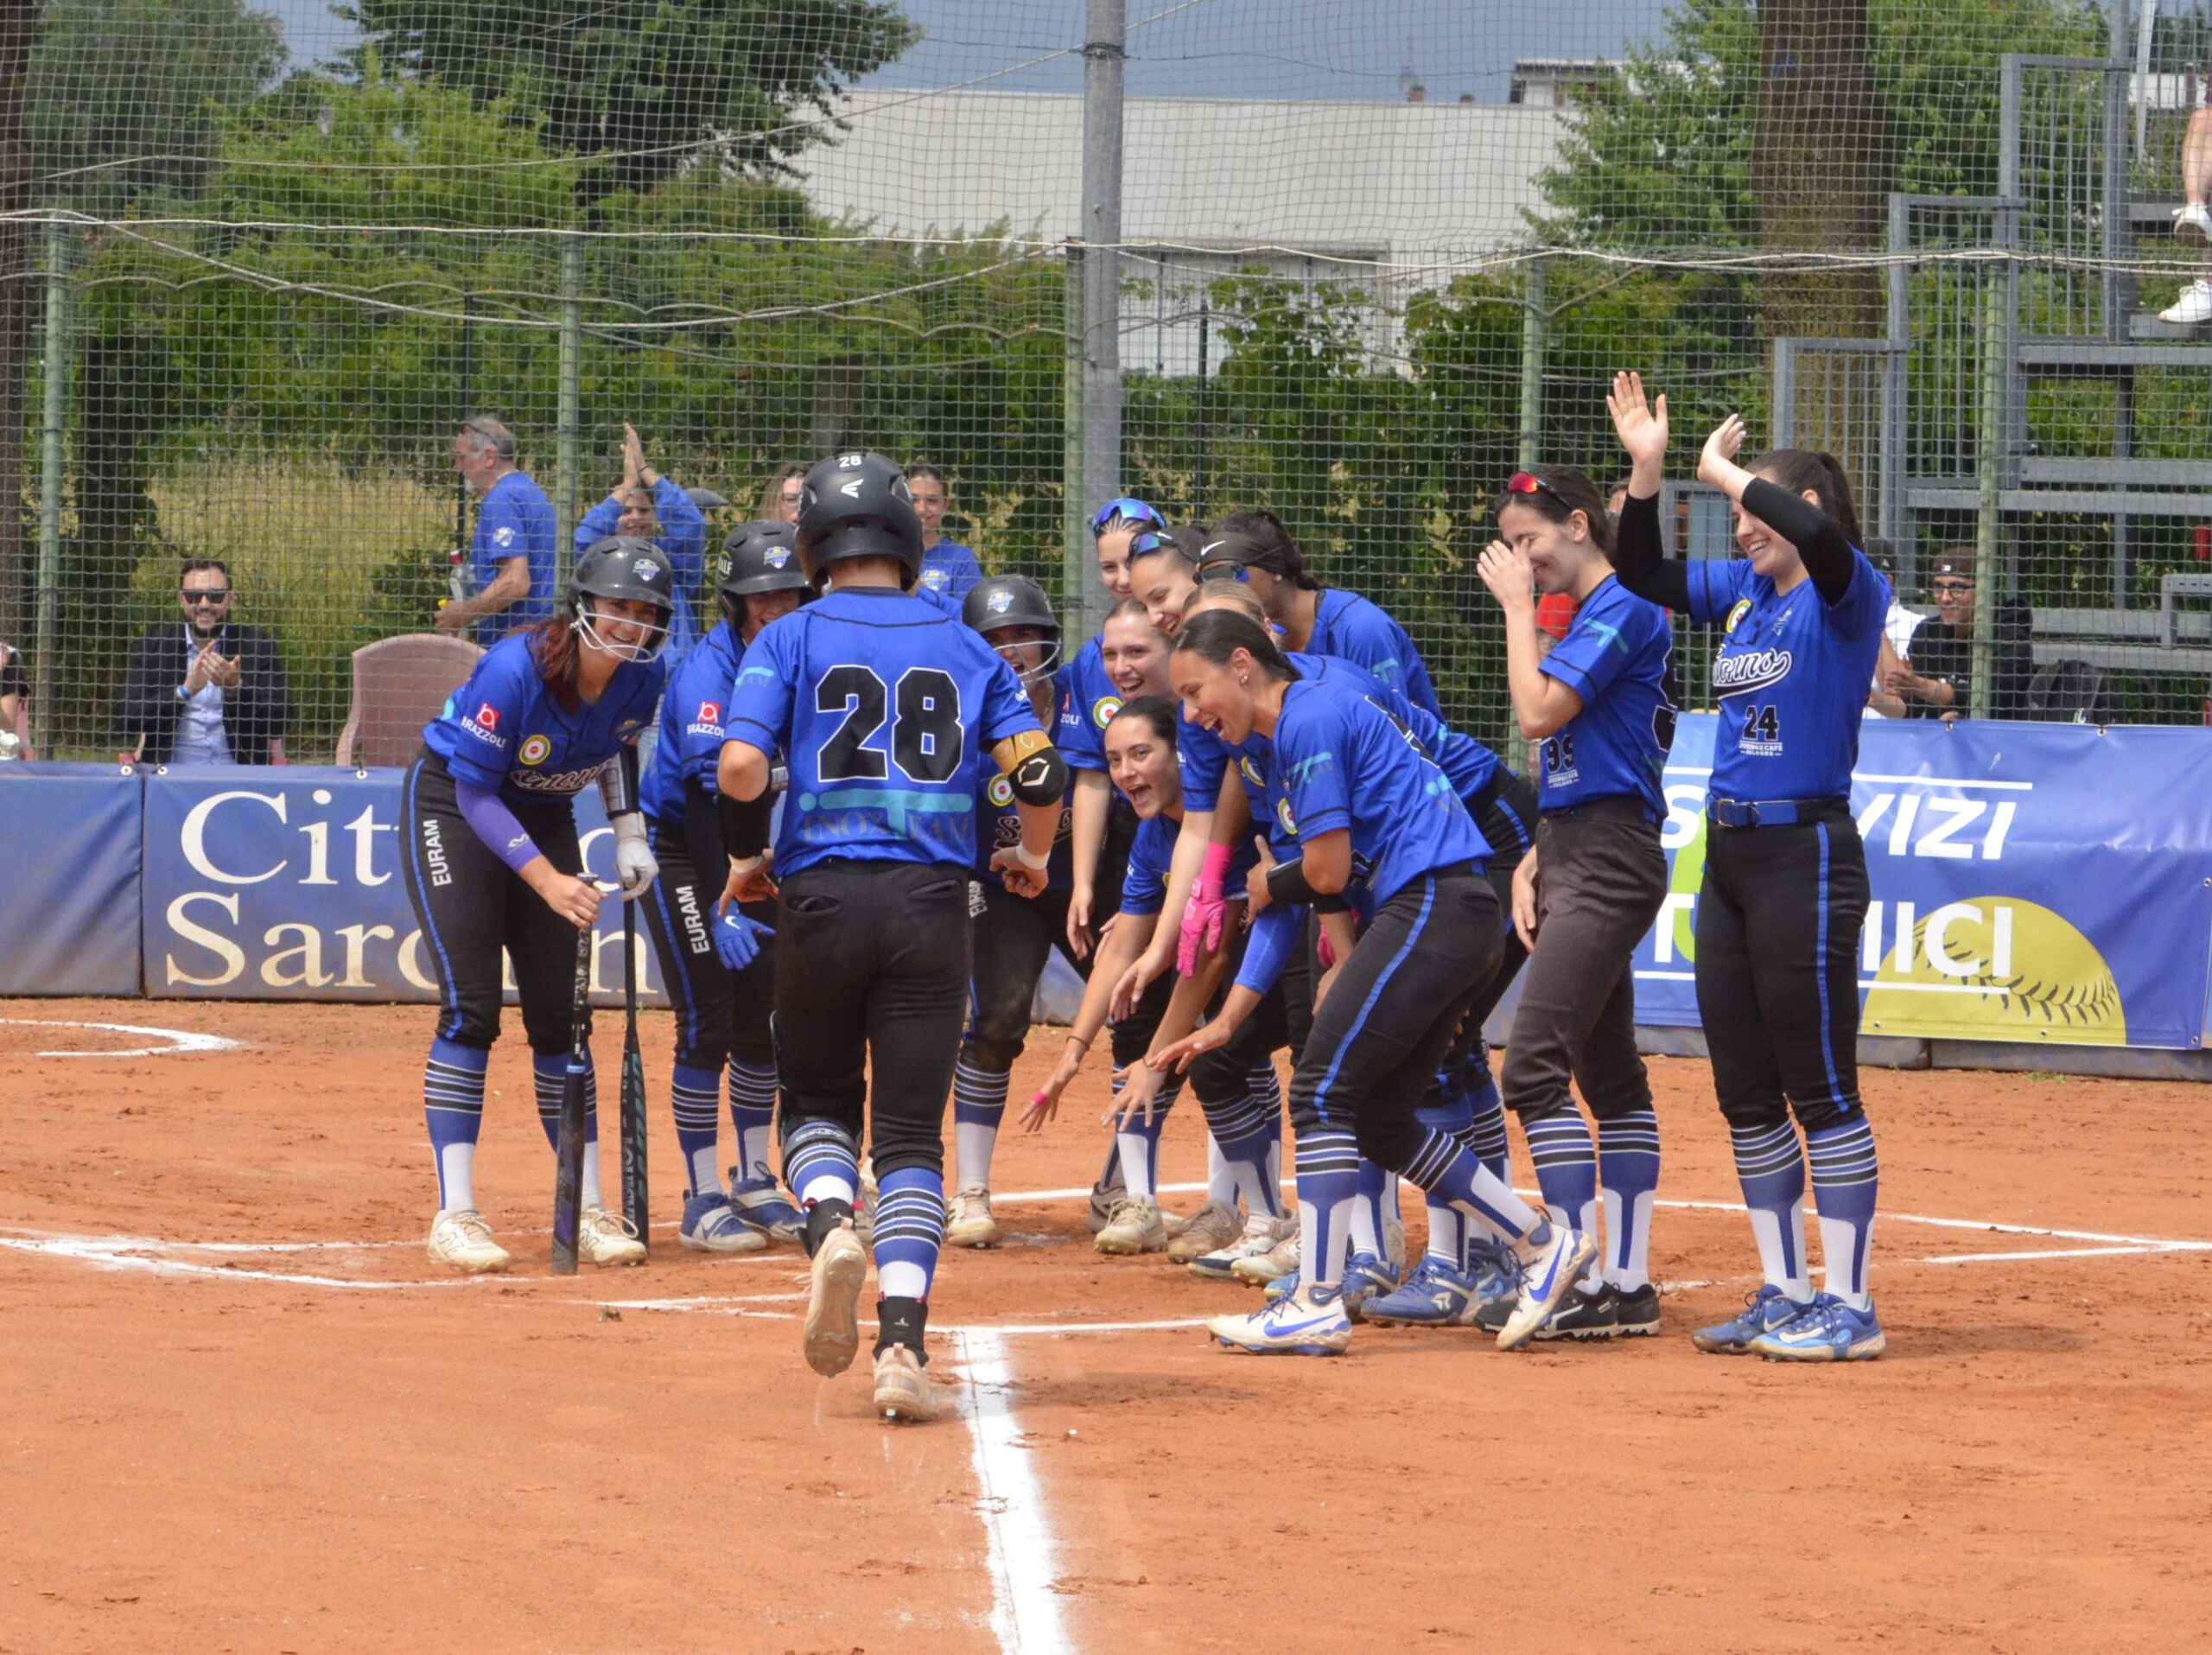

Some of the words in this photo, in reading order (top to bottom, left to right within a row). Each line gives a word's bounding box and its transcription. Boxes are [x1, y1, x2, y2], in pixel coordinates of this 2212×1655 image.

[839, 455, 862, 468] 28
[815, 664, 964, 784] 28
[1742, 704, 1780, 742] 24
[423, 819, 452, 887] EURAM
[676, 885, 710, 954] EURAM
